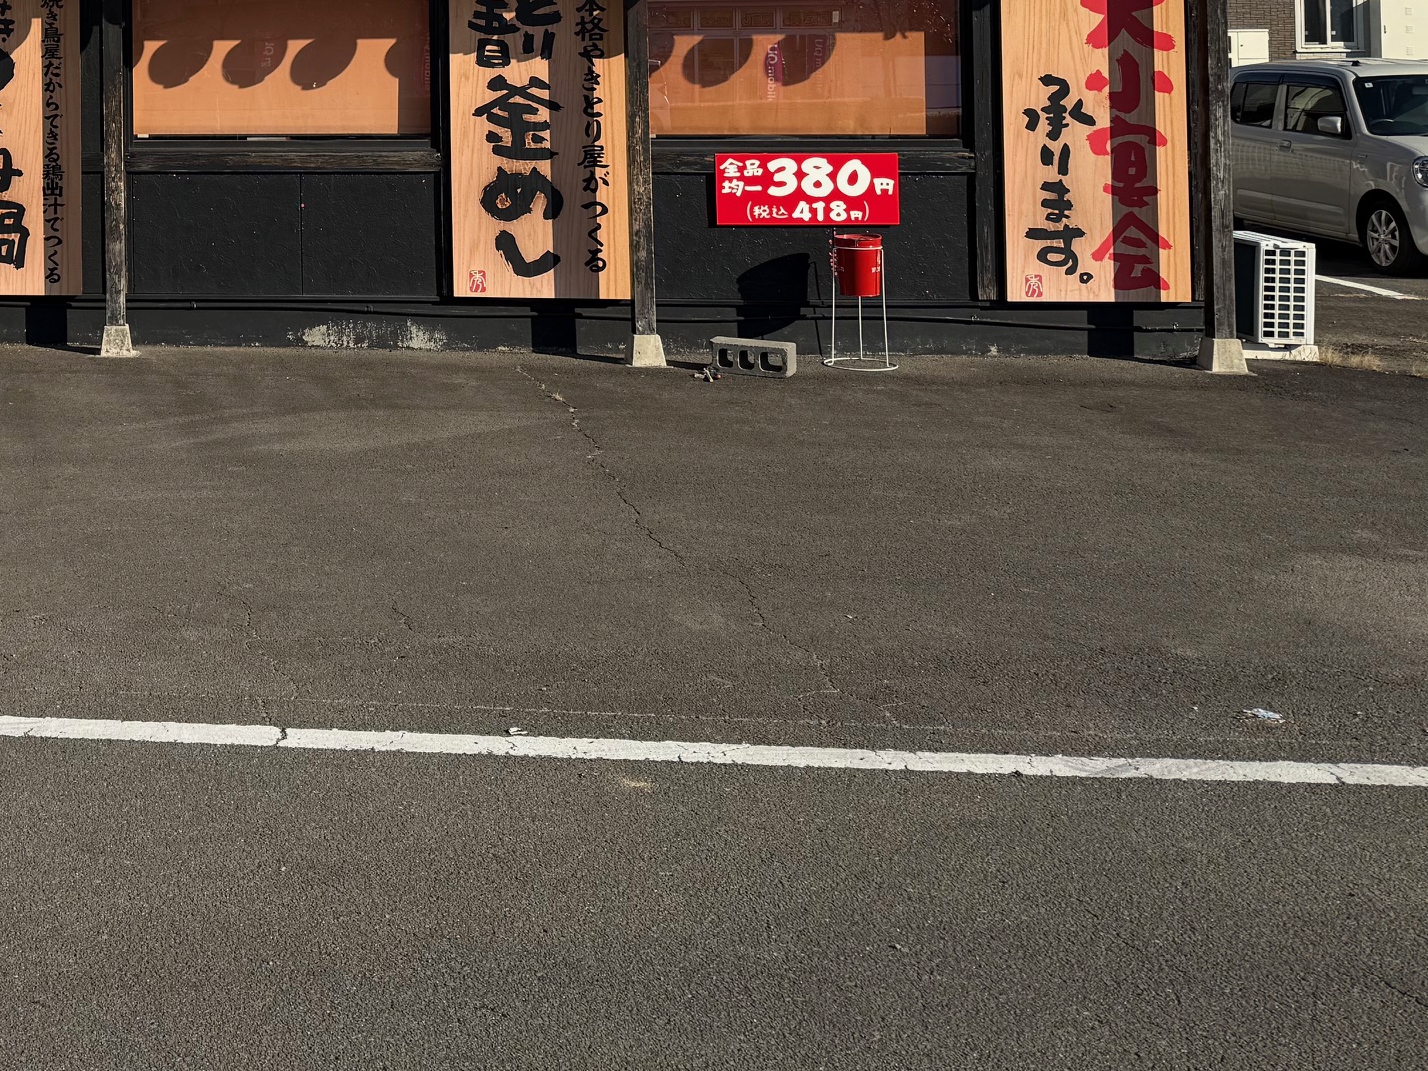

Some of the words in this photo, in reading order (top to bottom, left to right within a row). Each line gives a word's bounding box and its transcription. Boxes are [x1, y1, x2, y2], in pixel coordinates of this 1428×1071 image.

[472, 74, 565, 279] 釜めし
[719, 158, 764, 178] 全品
[721, 179, 763, 197] 均一
[1022, 73, 1097, 285] 承ります。
